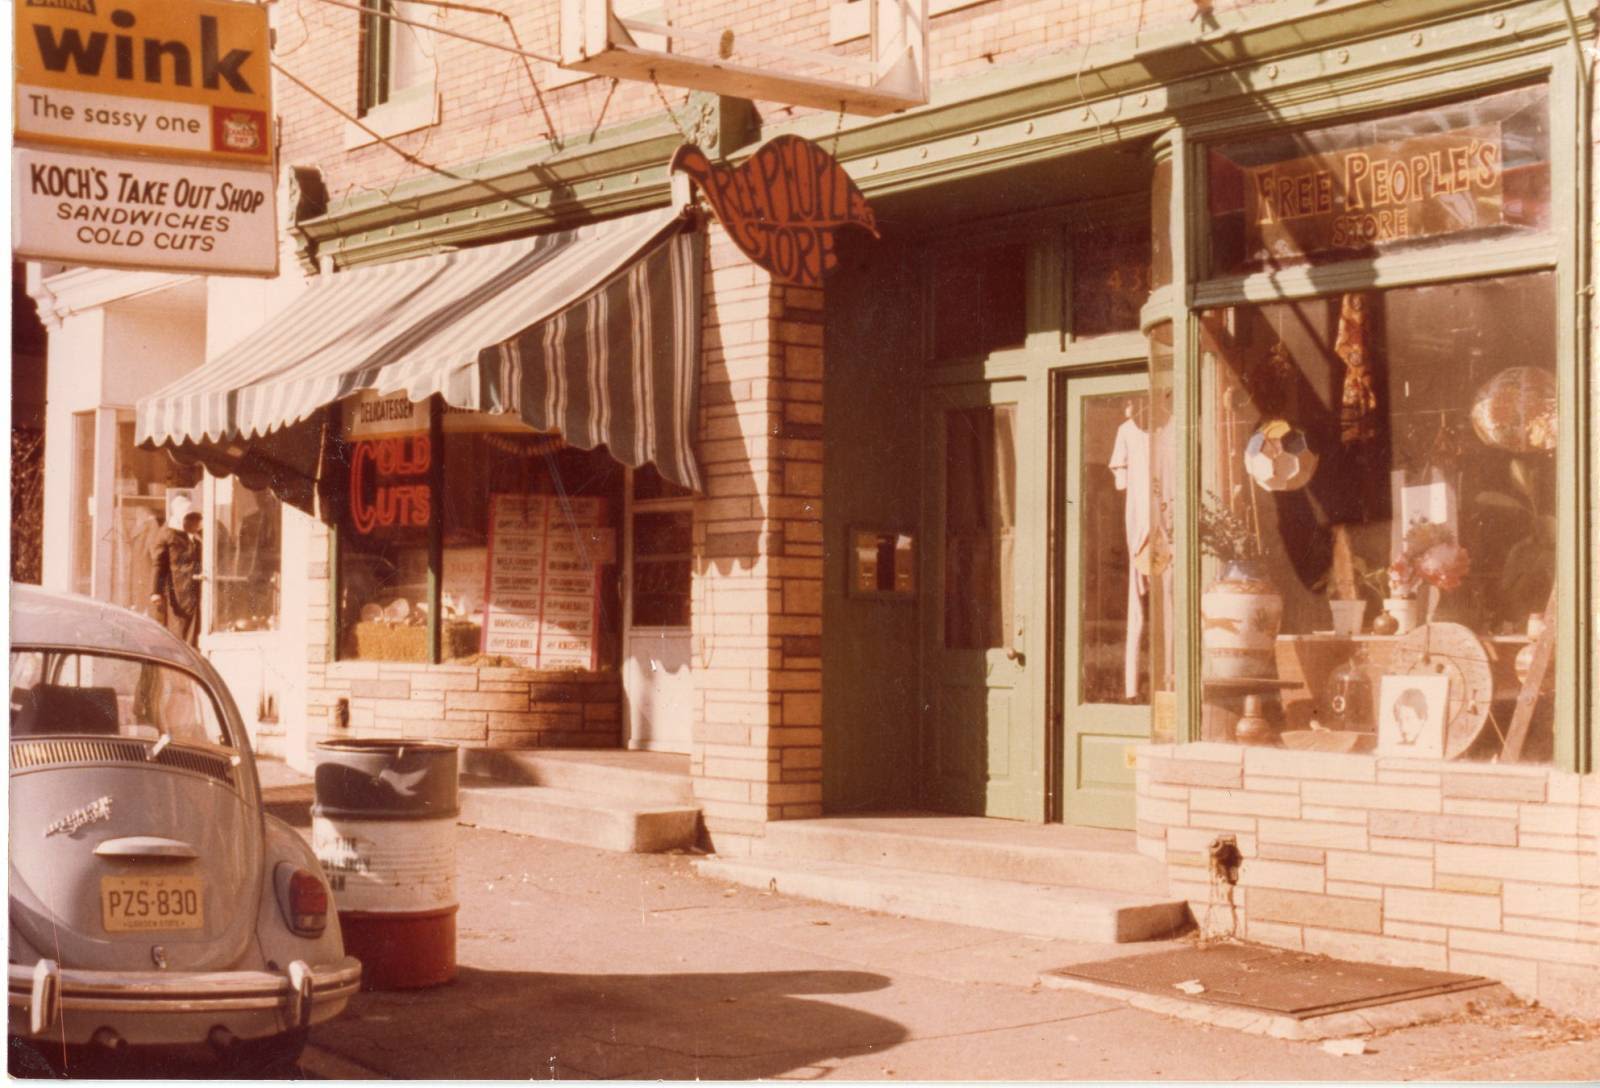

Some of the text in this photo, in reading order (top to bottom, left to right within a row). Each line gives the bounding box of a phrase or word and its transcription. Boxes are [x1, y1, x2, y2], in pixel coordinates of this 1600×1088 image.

[32, 9, 254, 94] wink
[28, 94, 201, 133] The sassy one
[31, 163, 265, 214] KOCH'S TAKE OUT SHOP
[1255, 137, 1497, 225] FREE PEOPLE'S
[57, 202, 230, 233] SANDWICHES
[1331, 207, 1408, 247] STORE
[77, 226, 216, 252] COLD CUTS
